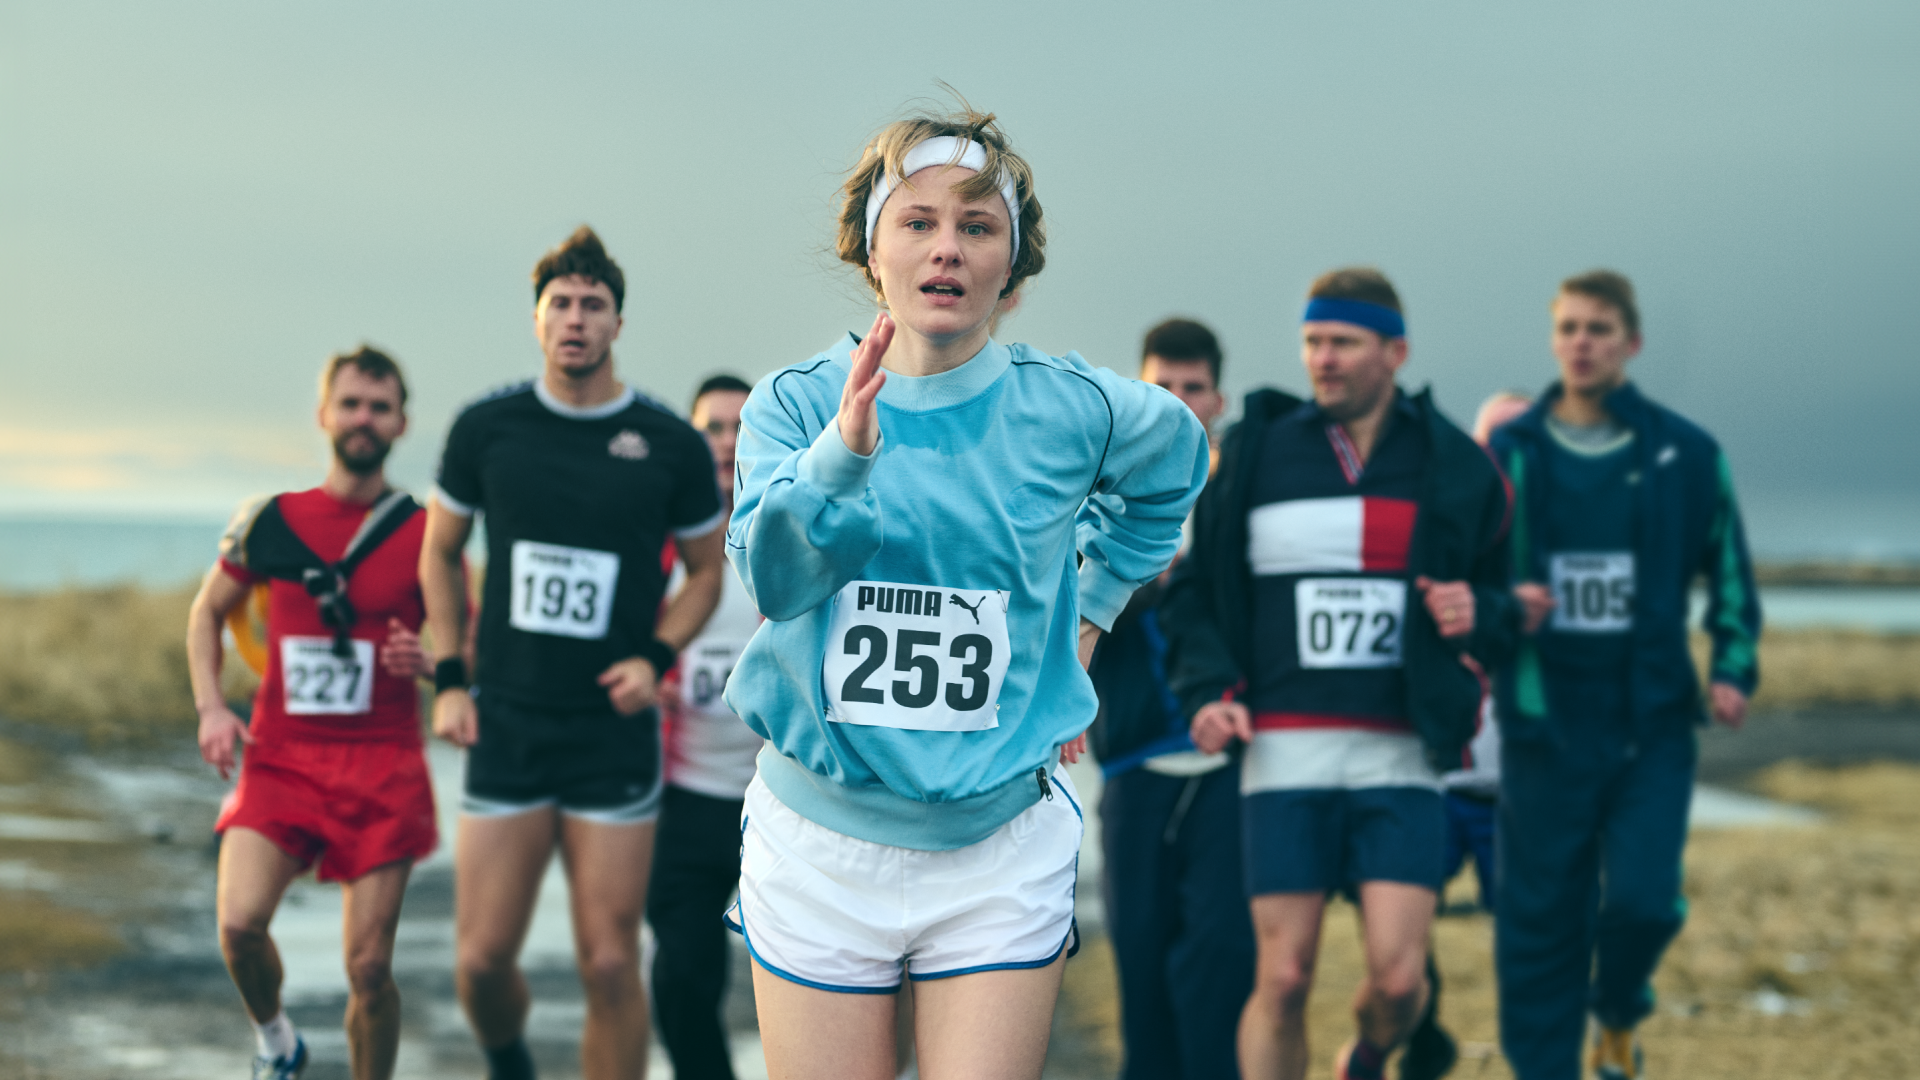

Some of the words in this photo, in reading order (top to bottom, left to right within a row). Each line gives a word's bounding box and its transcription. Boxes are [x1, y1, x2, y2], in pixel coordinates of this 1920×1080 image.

[524, 575, 598, 623] 193
[857, 585, 942, 617] PUMA
[1563, 578, 1633, 620] 105
[1309, 610, 1396, 655] 072
[289, 663, 362, 703] 227
[841, 624, 993, 712] 253
